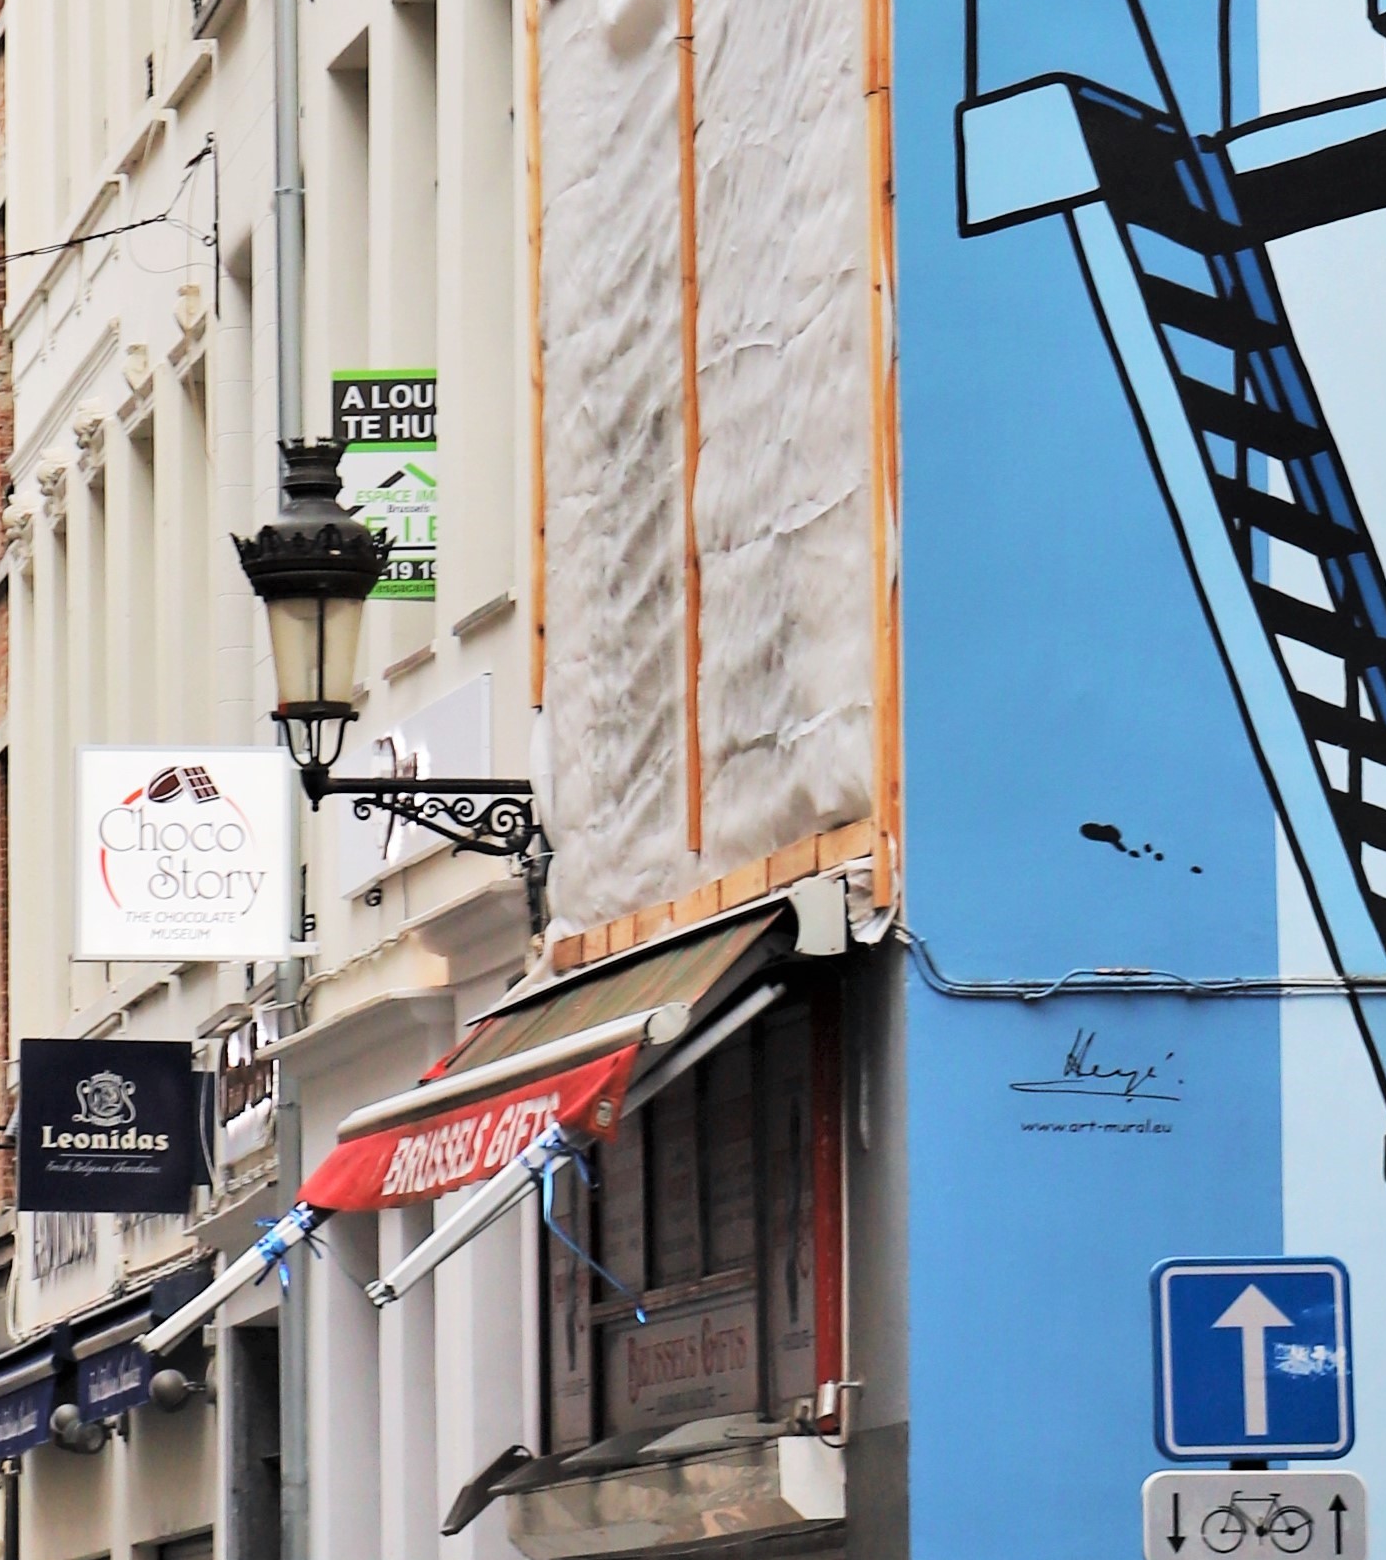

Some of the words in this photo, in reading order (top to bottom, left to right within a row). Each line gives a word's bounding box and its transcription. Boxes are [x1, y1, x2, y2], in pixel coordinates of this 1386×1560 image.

[340, 386, 365, 410] A
[370, 384, 435, 409] LOU
[341, 415, 381, 439] TE
[389, 414, 435, 440] HU
[355, 490, 411, 502] ESPACE
[98, 805, 246, 853] Choco
[147, 855, 268, 917] Story
[125, 911, 151, 924] THE
[154, 911, 237, 924] CHOCOLATE
[148, 928, 213, 941] MUSEUM
[41, 1125, 170, 1152] Leonidas
[1020, 1118, 1174, 1134] www.art-mural.eu
[380, 1111, 493, 1197] BRUSSELS
[483, 1091, 561, 1169] GIFTS
